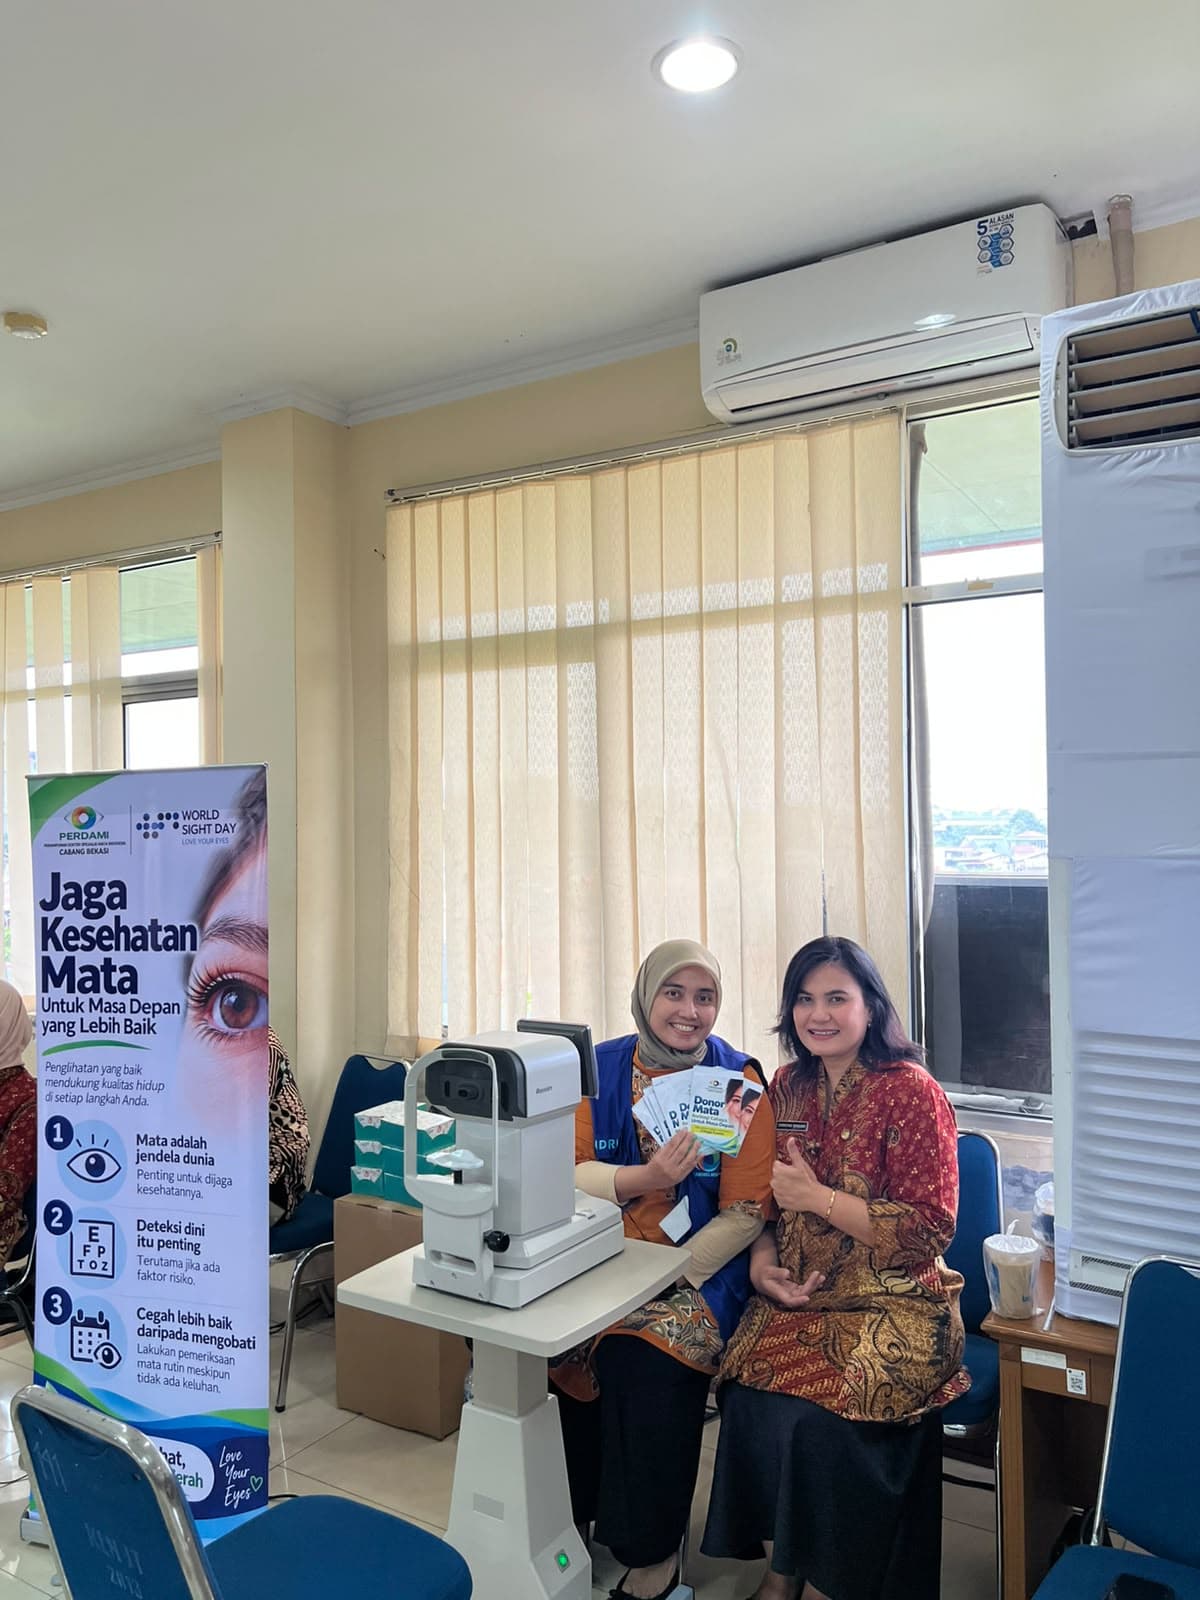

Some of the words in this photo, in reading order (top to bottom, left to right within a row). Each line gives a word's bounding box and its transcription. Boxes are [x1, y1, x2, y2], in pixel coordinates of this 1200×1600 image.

[977, 219, 989, 236] 5
[181, 809, 220, 821] WORLD
[59, 831, 110, 841] PERDAMI
[181, 824, 212, 835] SIGHT
[214, 822, 237, 834] DAY
[59, 848, 86, 856] CABANG
[86, 847, 110, 855] BEKASI
[39, 871, 128, 920] Jaga
[40, 915, 198, 952] Kesehatan
[40, 955, 138, 995] Mata
[41, 997, 85, 1014] Untuk
[89, 997, 126, 1014] Masa
[129, 998, 181, 1018] Depan
[41, 1018, 76, 1037] yang
[80, 1016, 120, 1034] Lebih
[124, 1017, 157, 1035] Baik
[45, 1061, 99, 1075] Penglihatan
[100, 1064, 121, 1077] yang
[123, 1063, 142, 1075] baik
[45, 1077, 100, 1091] mendukung
[101, 1079, 134, 1090] kualitas
[136, 1080, 165, 1093] hidup
[45, 1091, 53, 1102] di
[54, 1092, 83, 1105] setiap
[85, 1092, 120, 1106] langkah
[121, 1095, 150, 1107] Anda.
[694, 1095, 726, 1108] Donor
[692, 1104, 720, 1116] Mata
[52, 1122, 64, 1143] 1
[136, 1133, 168, 1147] Mata
[170, 1134, 207, 1150] adalah
[135, 1148, 180, 1165] jendela
[183, 1151, 215, 1166] dunia
[136, 1168, 175, 1184] Penting
[176, 1172, 203, 1183] untuk
[204, 1173, 233, 1189] dijaga
[136, 1183, 204, 1200] kesehatannya.
[50, 1206, 63, 1228] 2
[88, 1226, 100, 1242] E
[136, 1218, 182, 1234] Deteksi
[184, 1221, 205, 1237] dini
[137, 1234, 154, 1248] itu
[157, 1237, 201, 1255] penting
[136, 1254, 184, 1269] Terutama
[184, 1258, 201, 1272] jika
[202, 1260, 221, 1273] ada
[137, 1268, 167, 1281] faktor
[169, 1271, 196, 1286] risiko.
[50, 1293, 63, 1318] 3
[136, 1306, 175, 1324] Cegah
[177, 1309, 206, 1327] lebih
[208, 1313, 233, 1331] baik
[137, 1323, 189, 1342] daripada
[191, 1332, 256, 1350] mengobati
[137, 1343, 176, 1358] Lakukan
[178, 1348, 236, 1366] pemeriksaan
[137, 1360, 162, 1370] mata
[163, 1361, 185, 1373] rutin
[186, 1365, 231, 1380] meskipun
[137, 1371, 161, 1385] tidak
[163, 1375, 181, 1388] ada
[182, 1377, 221, 1394] keluhan.
[219, 1445, 243, 1468] Love
[172, 1469, 204, 1489] erah
[225, 1464, 250, 1485] Your
[224, 1484, 251, 1510] Eyes
